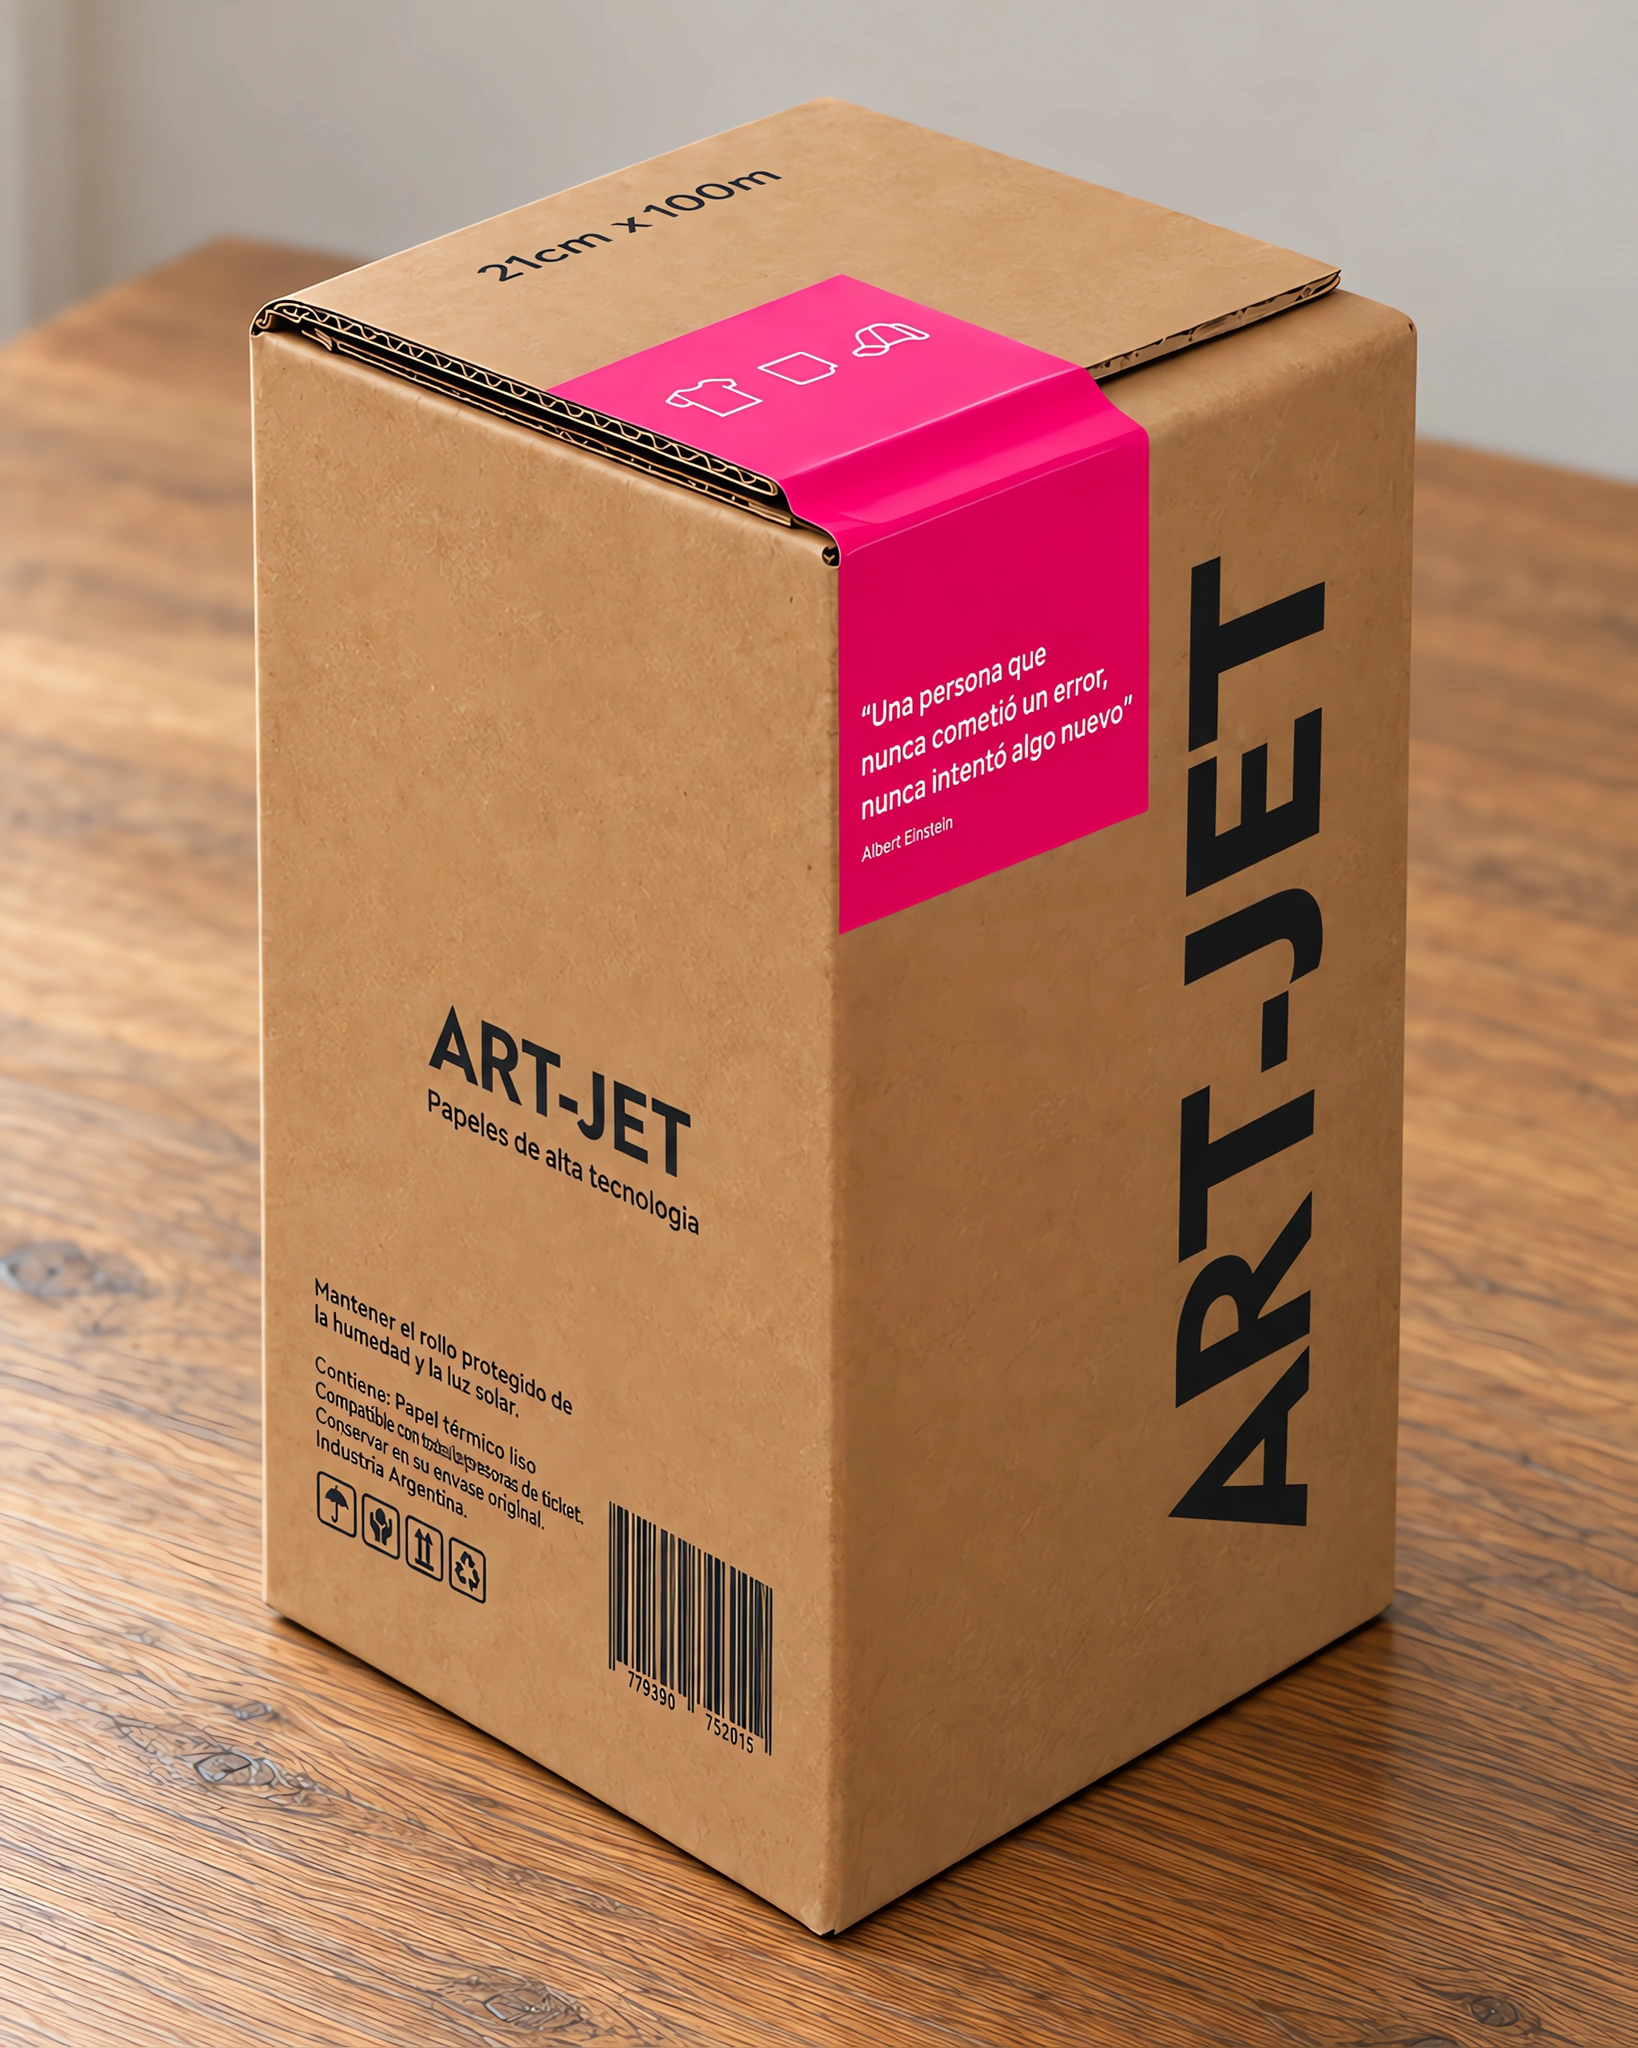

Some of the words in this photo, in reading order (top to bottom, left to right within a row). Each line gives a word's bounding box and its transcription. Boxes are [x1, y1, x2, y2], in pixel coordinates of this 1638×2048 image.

[477, 232, 613, 282] 21cm
[610, 216, 653, 233] x
[643, 170, 782, 218] 100m
[861, 735, 926, 776] nunca
[932, 695, 1017, 749] cometió
[1022, 690, 1048, 715] un
[1053, 668, 1108, 703] error,
[919, 663, 1002, 716] persona
[1008, 646, 1046, 681] que
[861, 779, 926, 820] nunca
[932, 743, 1007, 794] intentó
[1011, 730, 1056, 761] algo
[861, 836, 901, 862] Albert
[904, 816, 953, 847] Einstein
[428, 1005, 691, 1178] ART-JET
[1167, 556, 1326, 1527] ART-JET
[428, 1088, 509, 1147] Papeles
[514, 1132, 540, 1161] de
[546, 1148, 583, 1182] alta
[589, 1164, 699, 1235] tecnologia
[314, 1277, 396, 1331] Mantener
[400, 1320, 416, 1341] el
[420, 1330, 457, 1359] rollo
[462, 1349, 546, 1402] protegido
[551, 1390, 573, 1416] de
[314, 1303, 328, 1327] la
[333, 1311, 410, 1366] humedad
[415, 1354, 425, 1376] y
[428, 1356, 443, 1382] la
[447, 1365, 471, 1394] luz
[475, 1384, 519, 1418] solar.
[315, 1356, 391, 1405] Contiene:
[395, 1392, 439, 1428] Papel
[443, 1415, 505, 1460] térmico
[509, 1446, 537, 1475] liso
[315, 1381, 395, 1433] Compatible
[397, 1423, 420, 1446] con
[521, 1480, 538, 1502] de
[316, 1406, 389, 1454] Conservar
[392, 1446, 410, 1465] en
[413, 1456, 430, 1475] su
[433, 1466, 484, 1500] envase
[316, 1429, 384, 1479] Industria
[389, 1466, 468, 1518] Argentina.
[627, 1670, 675, 1711] 779390
[705, 1713, 754, 1753] 752015
